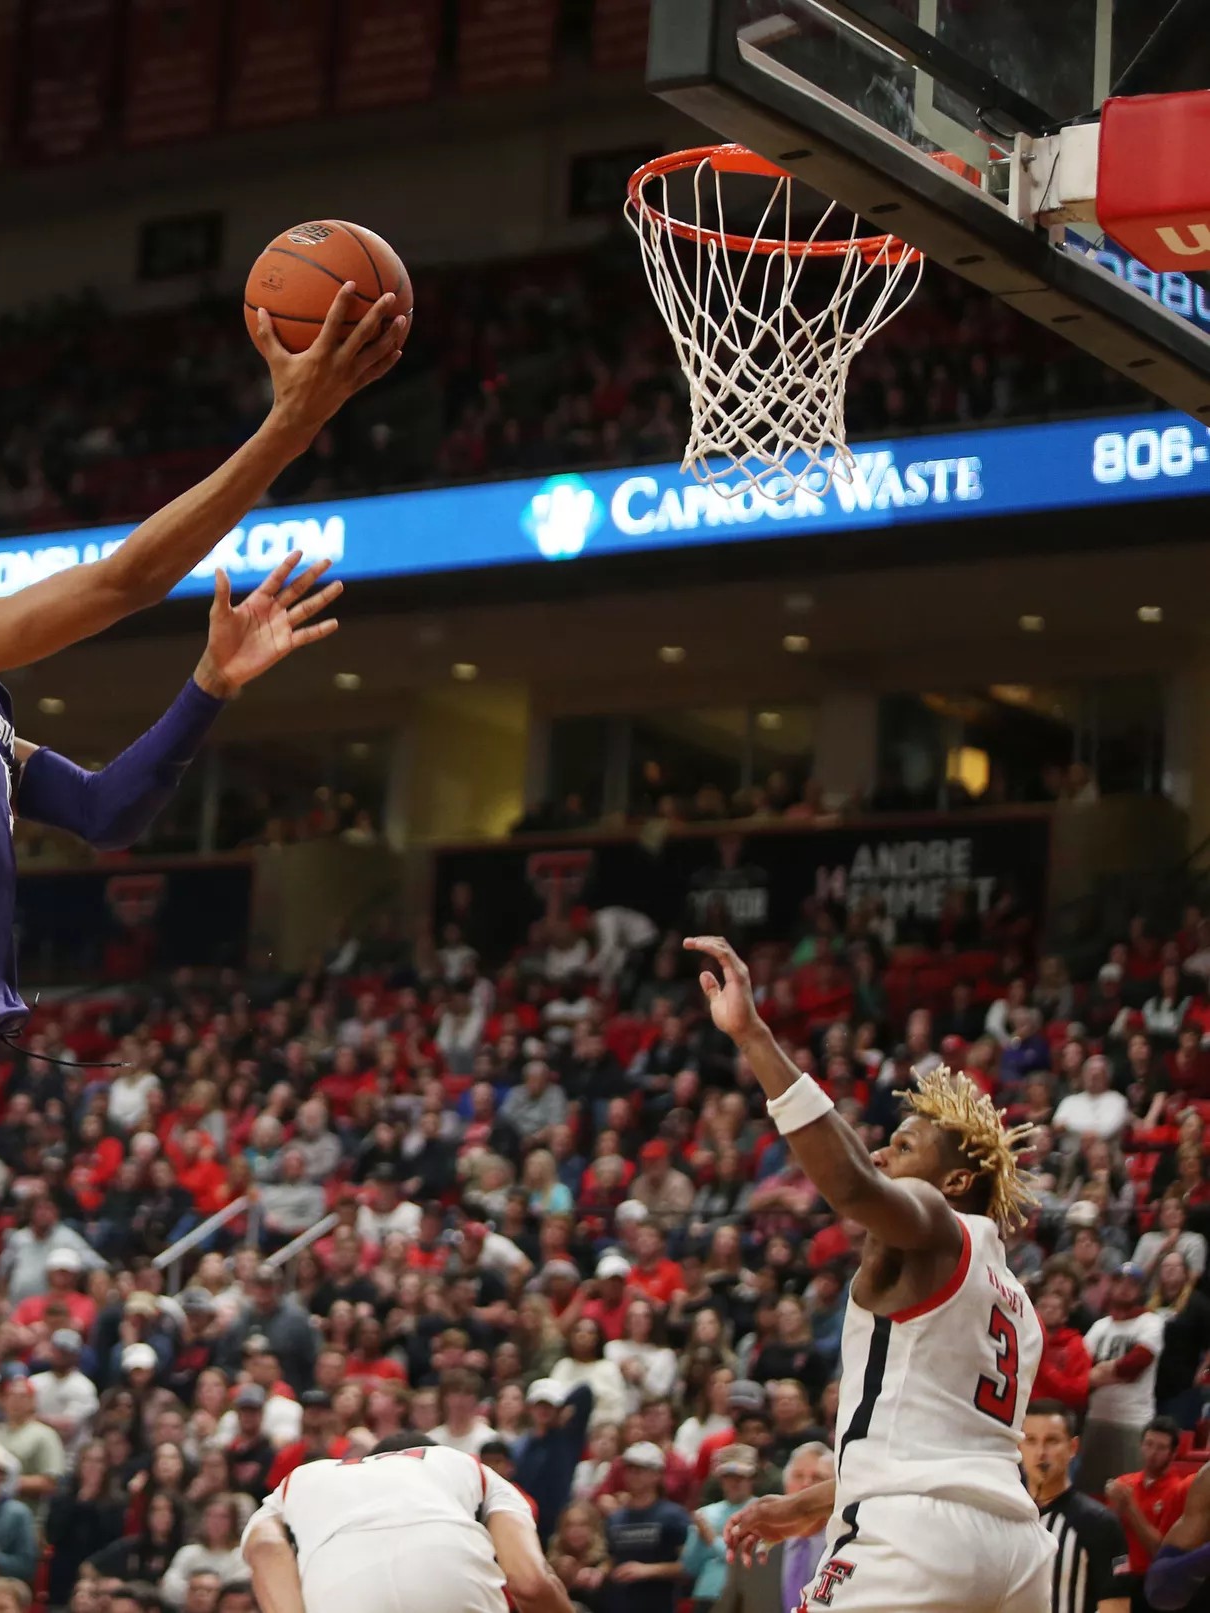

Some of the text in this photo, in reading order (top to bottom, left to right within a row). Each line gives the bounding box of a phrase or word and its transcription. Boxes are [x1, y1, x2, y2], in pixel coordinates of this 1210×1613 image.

[826, 450, 984, 514] WASTE
[1093, 425, 1210, 484] 806-
[851, 837, 973, 877] ANDRE
[973, 1303, 1020, 1428] 3
